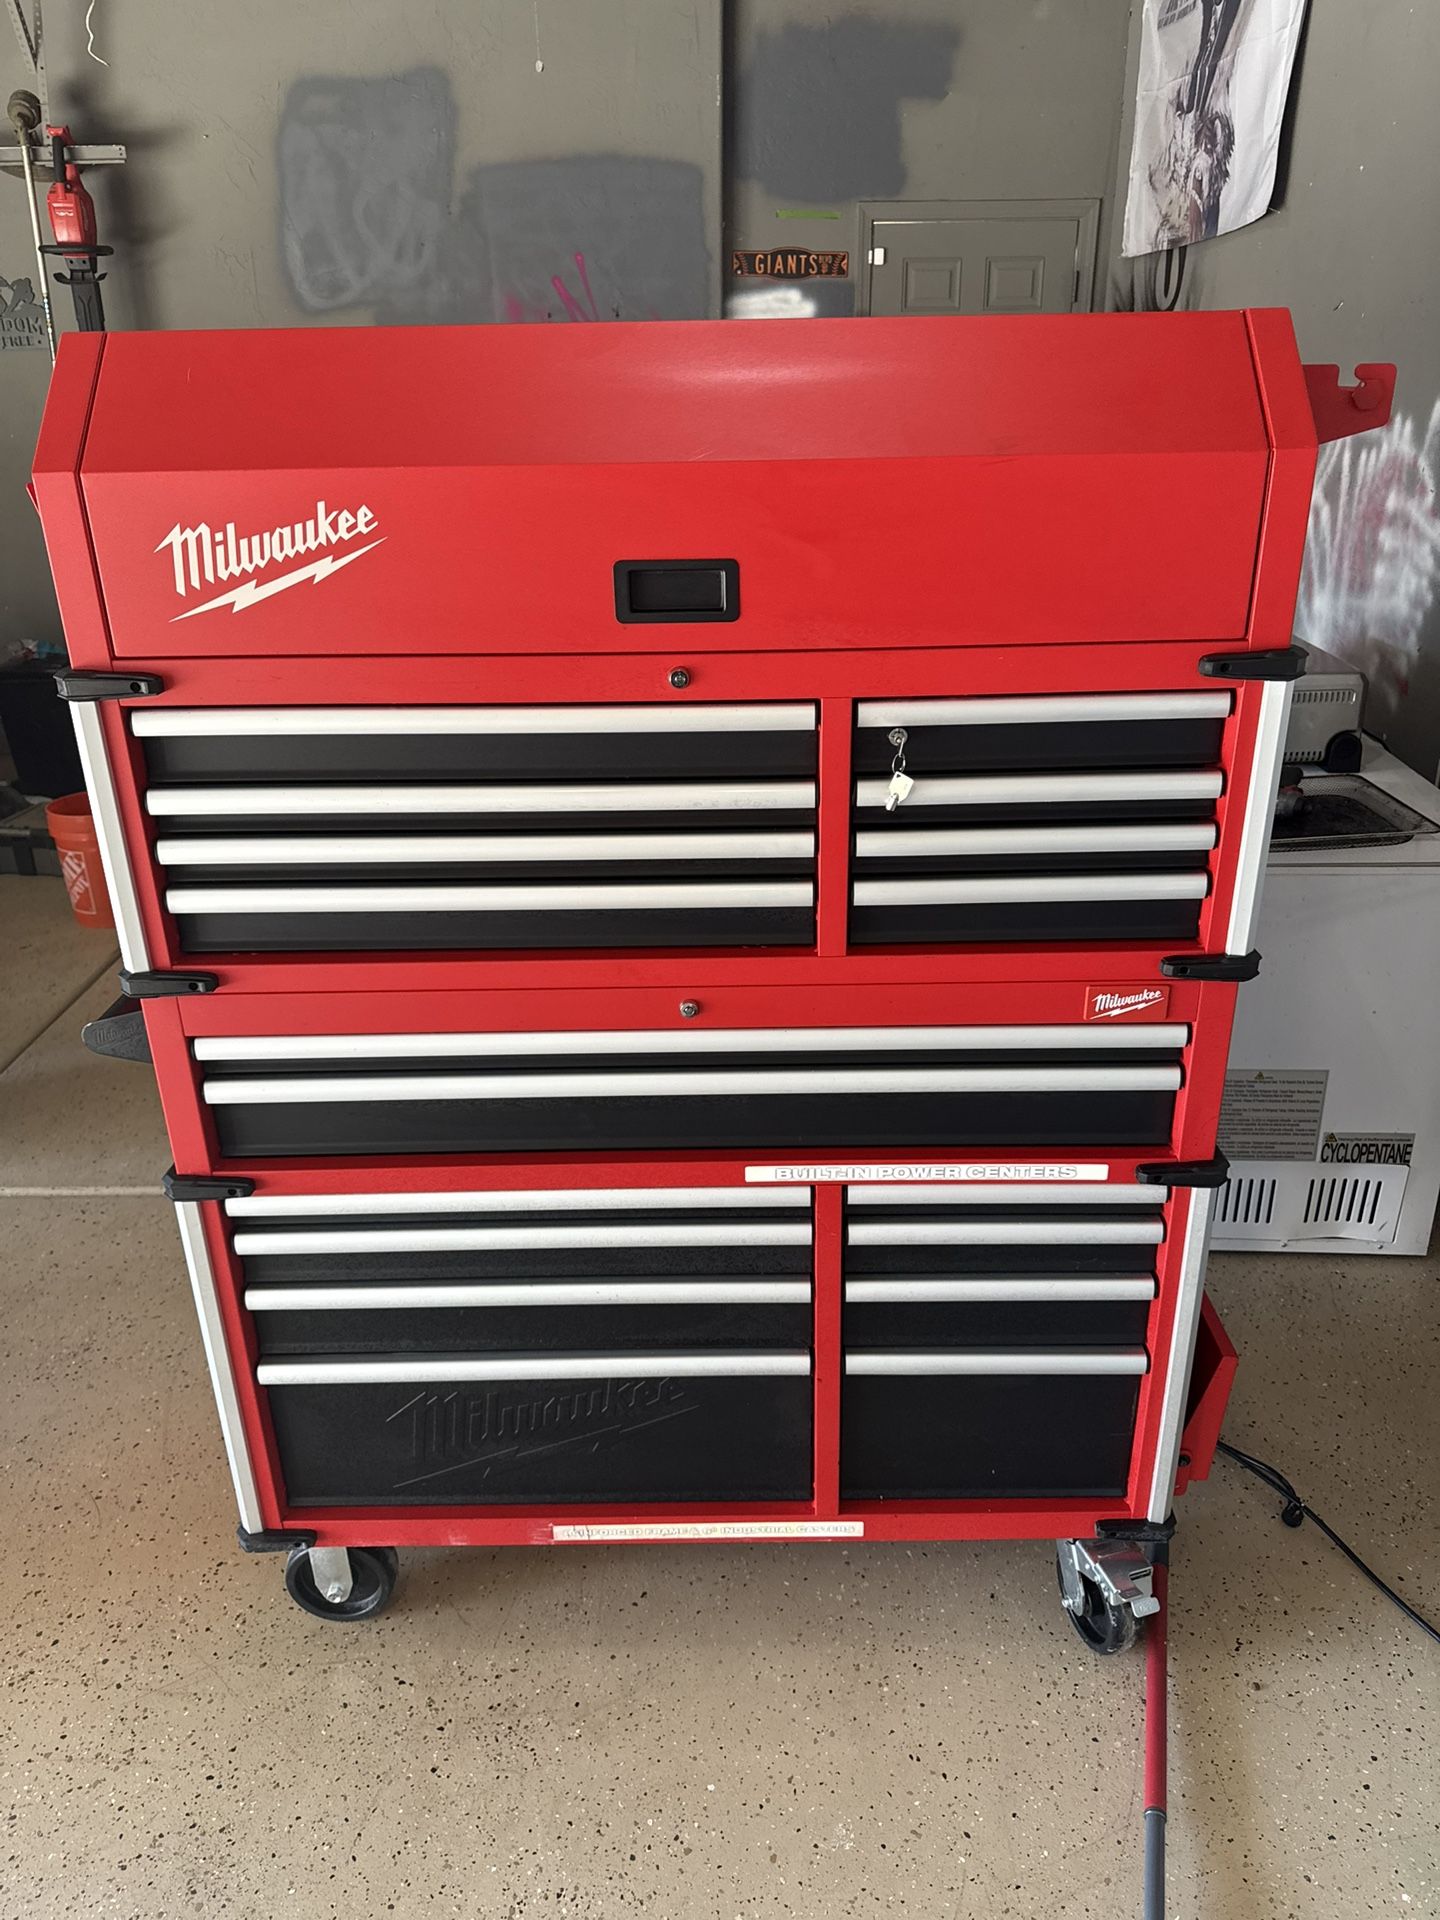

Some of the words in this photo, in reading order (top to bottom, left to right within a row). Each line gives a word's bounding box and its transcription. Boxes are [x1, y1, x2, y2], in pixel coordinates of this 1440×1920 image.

[755, 254, 818, 274] GIANTS
[153, 500, 379, 597] Milwaukee
[1091, 989, 1162, 1012] Milwaukee
[1320, 1142, 1415, 1164] CYCLOPENTANE
[775, 1167, 872, 1180] BUILT-IN
[878, 1166, 962, 1179] POWER
[966, 1165, 1080, 1179] CENTERS
